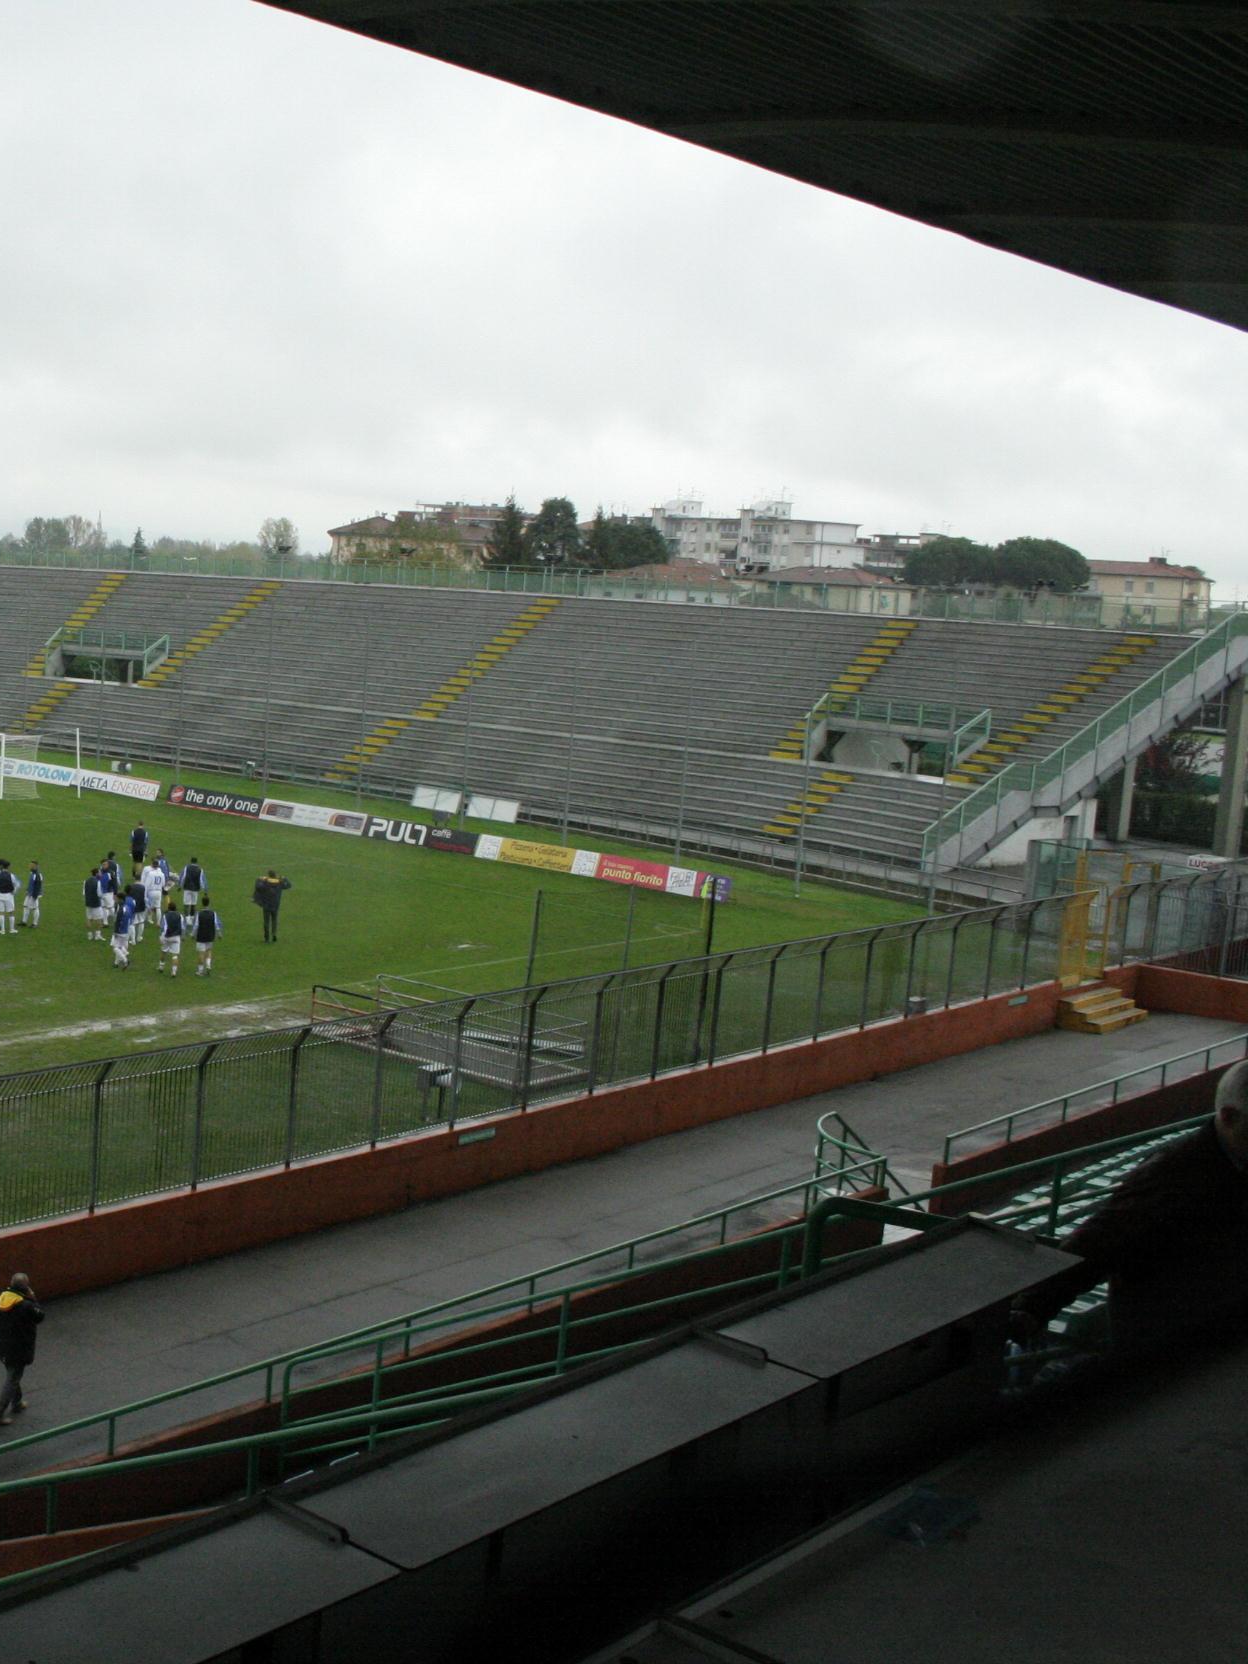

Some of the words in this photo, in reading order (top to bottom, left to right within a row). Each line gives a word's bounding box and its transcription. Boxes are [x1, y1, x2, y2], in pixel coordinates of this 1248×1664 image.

[16, 763, 73, 782] ROTOLONI
[80, 776, 109, 790] META
[111, 781, 157, 797] ENERGIA
[186, 789, 204, 803] the
[207, 795, 233, 811] only
[235, 800, 259, 813] one
[602, 867, 633, 880] punto
[633, 871, 663, 886] fiorito
